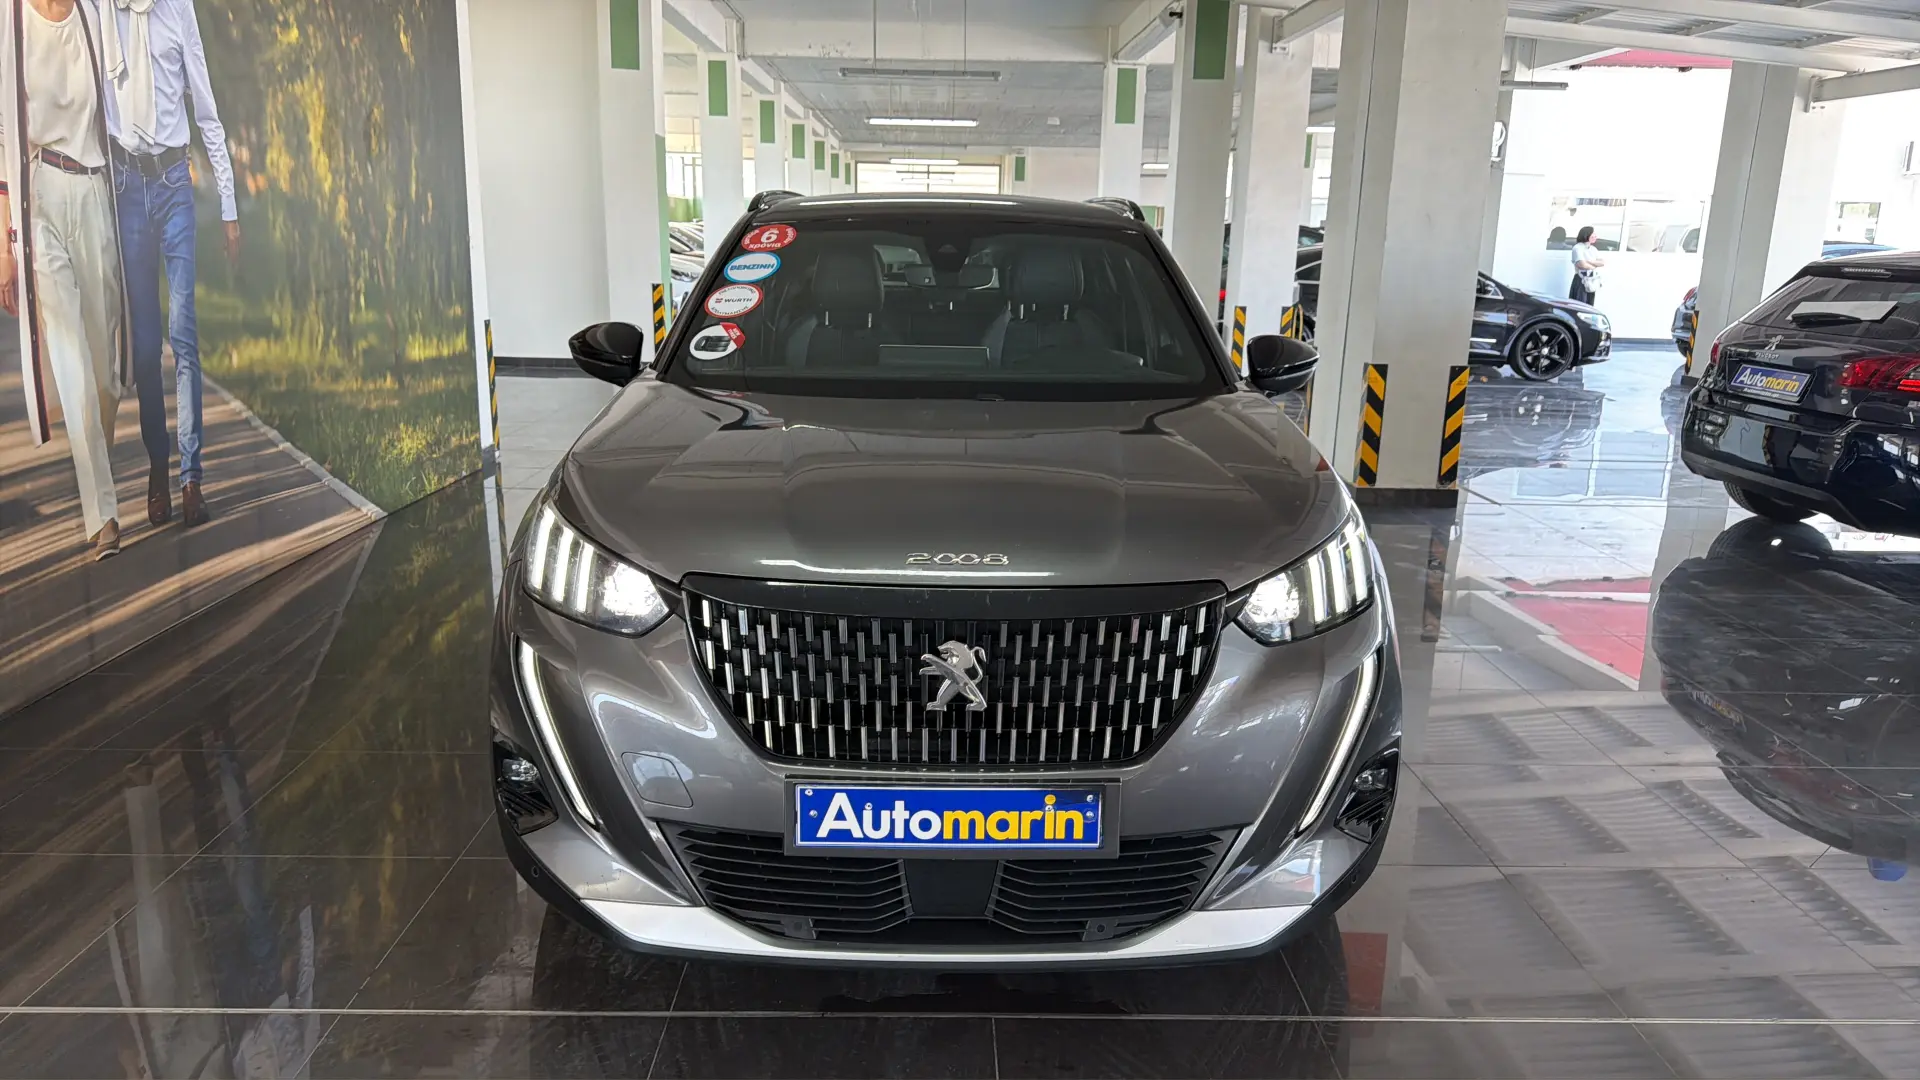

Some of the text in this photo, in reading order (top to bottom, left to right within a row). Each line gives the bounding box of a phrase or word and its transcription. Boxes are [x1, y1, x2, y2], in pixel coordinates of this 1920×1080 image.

[761, 230, 779, 243] 6
[1736, 367, 1800, 393] Automarin
[905, 552, 1009, 565] 2008
[816, 792, 1084, 840] Automarin
